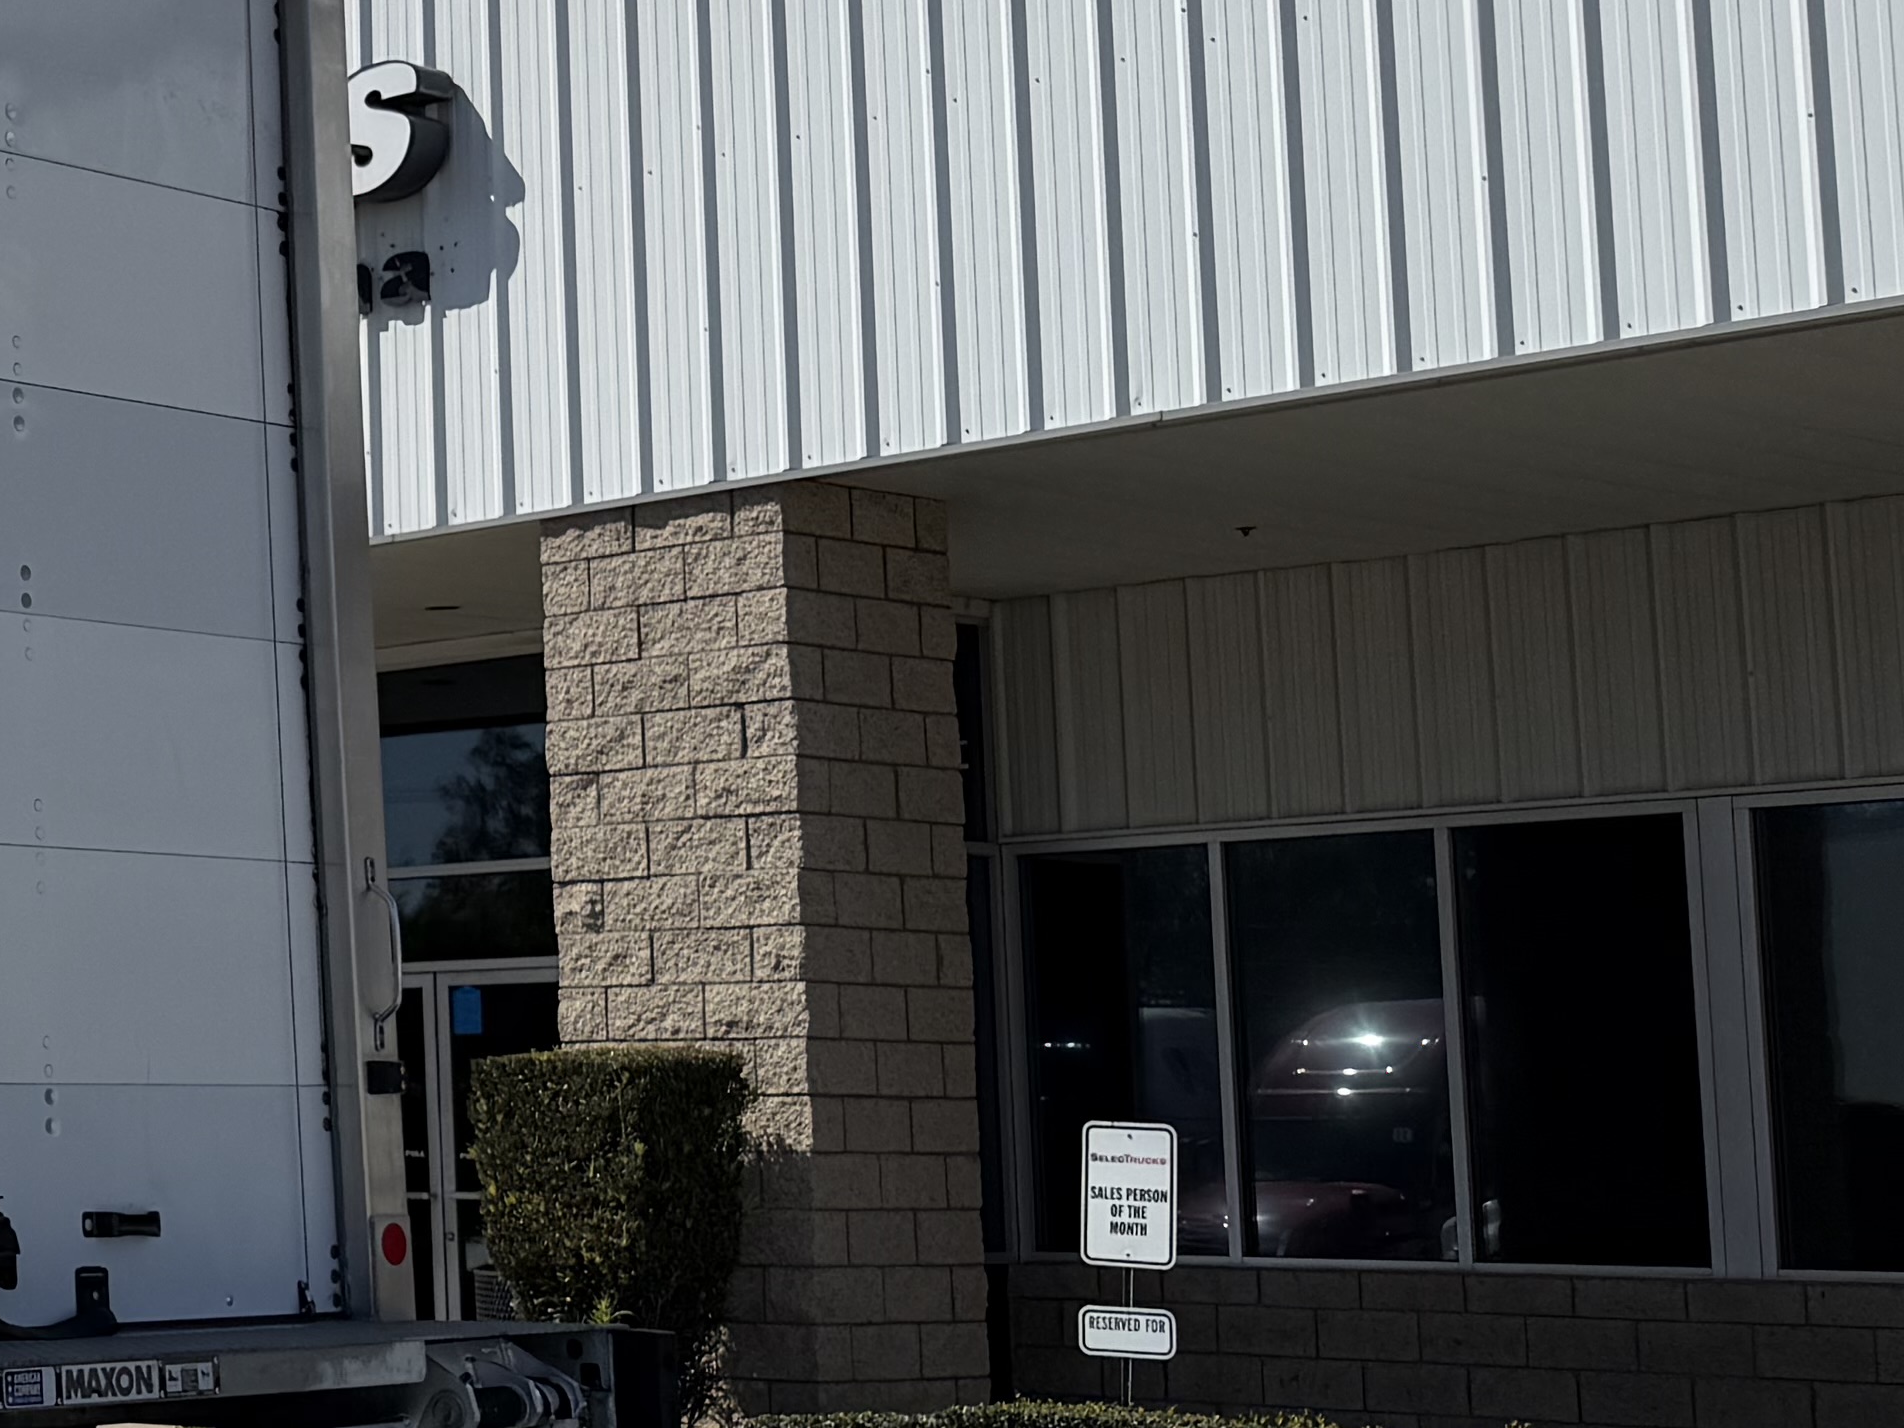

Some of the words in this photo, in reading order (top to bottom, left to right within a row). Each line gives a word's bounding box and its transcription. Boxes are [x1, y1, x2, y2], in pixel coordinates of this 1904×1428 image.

[1090, 1185, 1123, 1200] SALES
[1126, 1187, 1168, 1203] PERSON
[1110, 1203, 1124, 1218] OF
[1127, 1204, 1147, 1219] THE
[1109, 1220, 1148, 1236] MONTH
[1089, 1315, 1141, 1332] RESERVED
[1145, 1318, 1166, 1333] FOR
[64, 1365, 154, 1400] MAXON
